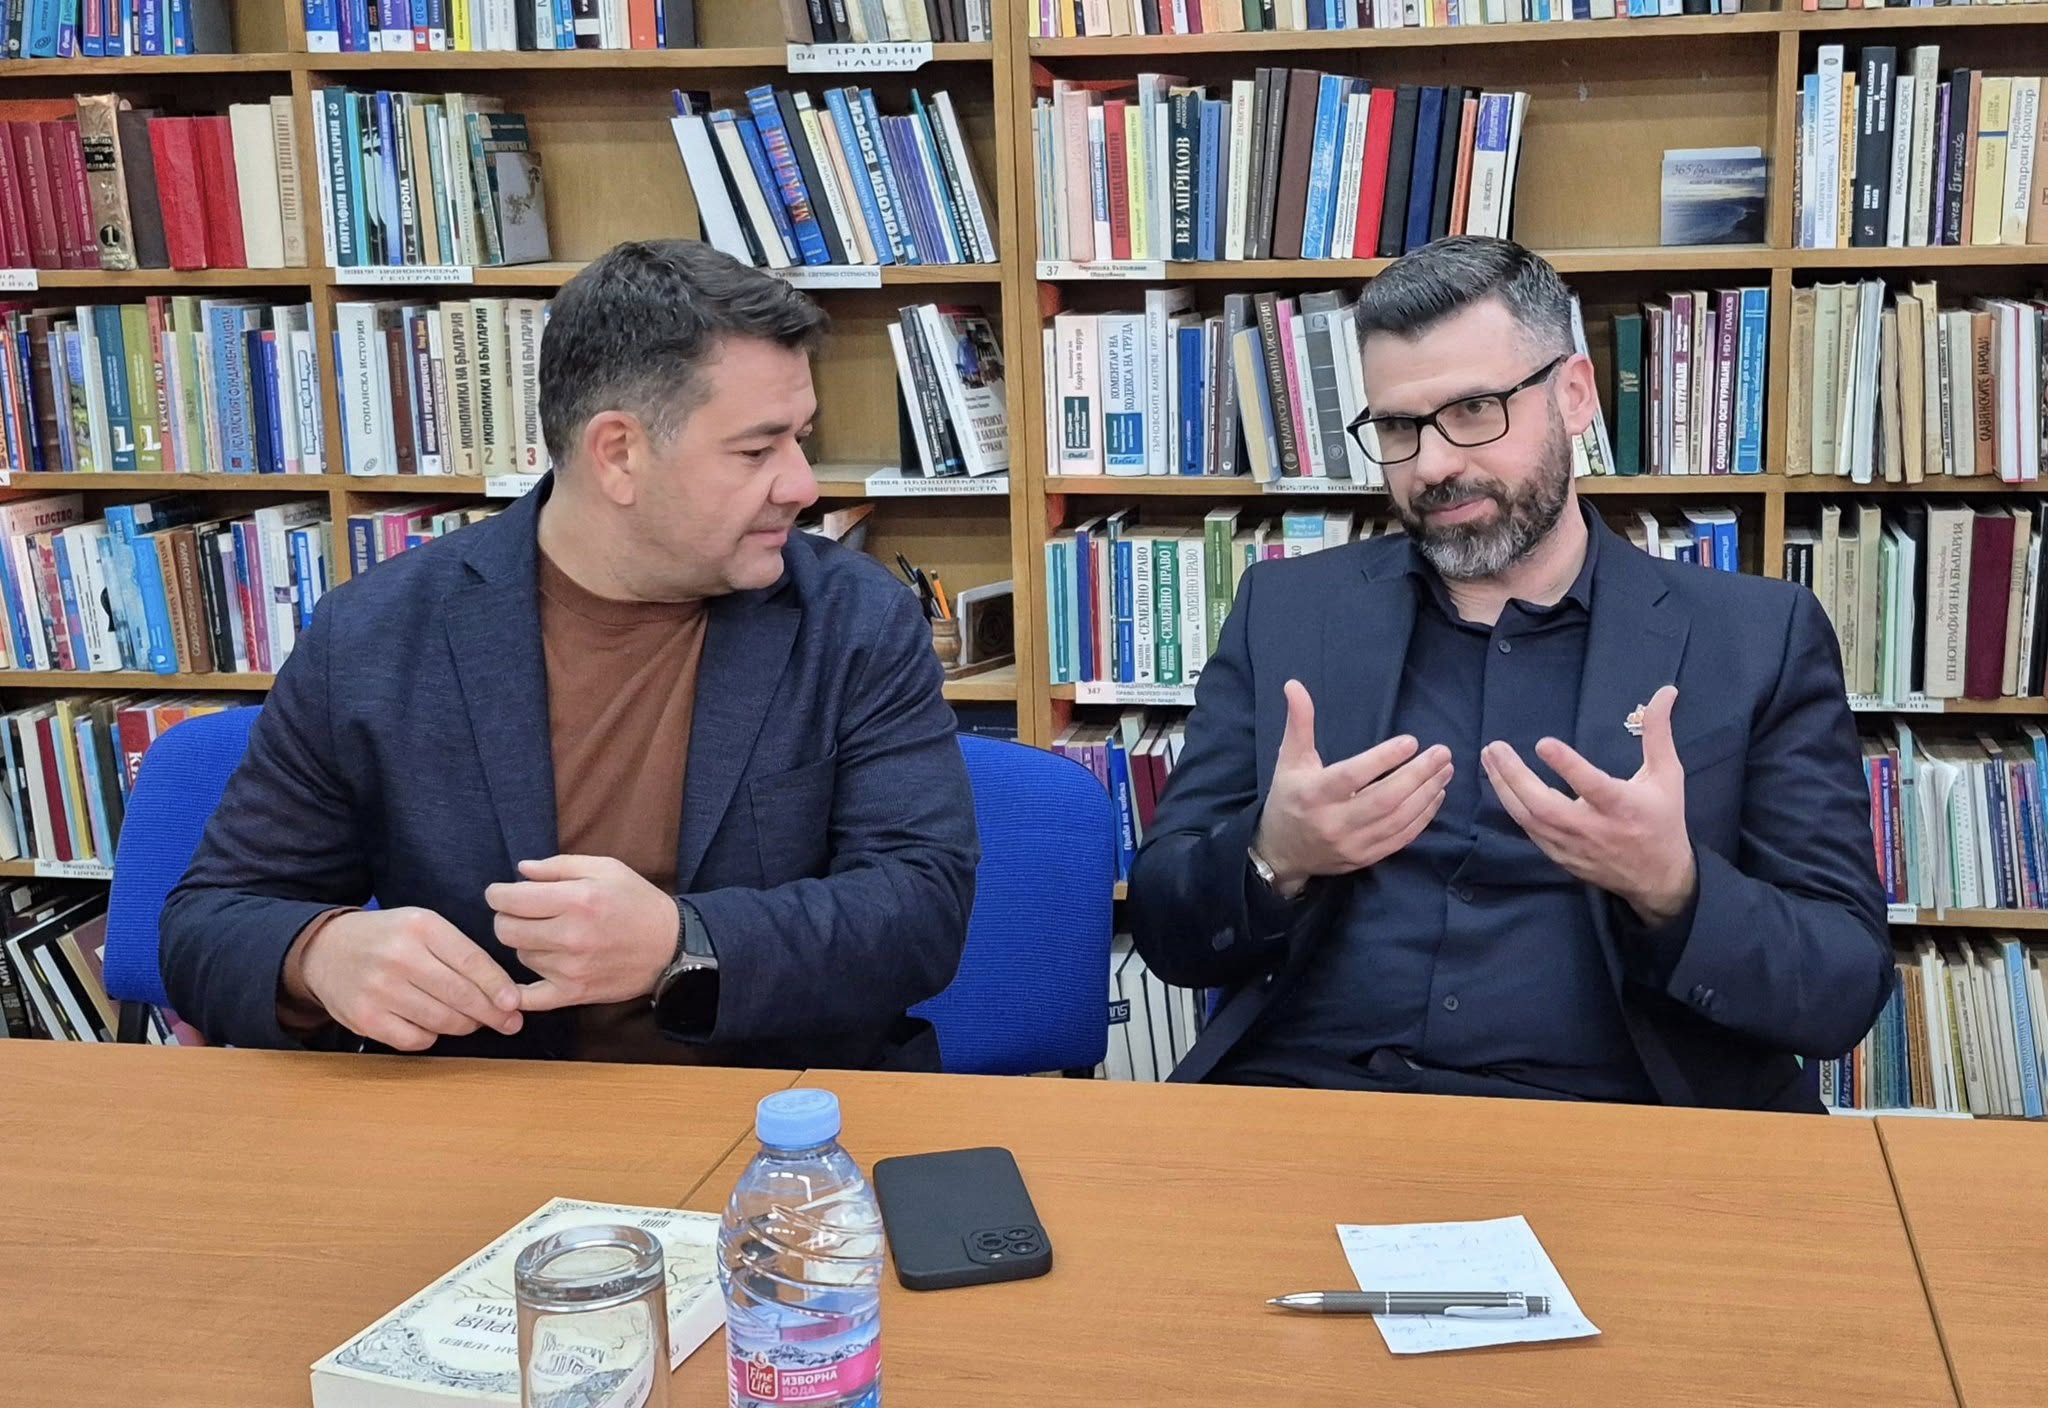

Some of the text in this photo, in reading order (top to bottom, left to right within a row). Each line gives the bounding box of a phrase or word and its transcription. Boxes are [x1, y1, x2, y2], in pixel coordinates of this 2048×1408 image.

[828, 46, 922, 56] ПРАВНИ
[837, 59, 914, 67] НАУКИ
[1822, 72, 1836, 146] АЛМАНАХ
[1897, 128, 1906, 140] НА
[764, 128, 811, 223] МАРКЕТИНГ
[1175, 137, 1191, 215] АПРИЛОВ
[1895, 144, 1906, 195] РАЖДАНЕТО
[2015, 89, 2036, 210] Български фолклор
[334, 177, 345, 191] НА
[401, 178, 413, 225] ЕВРОПА
[849, 101, 904, 256] СТОКОВИ БОРСИ
[336, 194, 351, 254] ГЕОГРАФИЯ
[949, 200, 969, 256] МАРКЕТИНГ
[966, 189, 990, 256] МАРКЕТИНГ
[1046, 266, 1059, 276] 37
[451, 312, 469, 365] БЪЛГАРИЯ
[1260, 301, 1277, 350] ИСТОРИЯ
[1724, 296, 1734, 330] ПАВЛОВ
[357, 320, 373, 435] СТОПАНСКА ИСТОРИЯ
[456, 367, 466, 380] НА
[476, 308, 494, 465] 2 ИКОНОМИКА НА БЪЛГАРИЯ
[520, 309, 537, 465] 3 ИКОНОМИКА НА БЪЛГАРИЯ
[1109, 335, 1120, 399] КОМЕНТАР НА
[1123, 323, 1136, 410] КОДЕКСА НА ТРУДА
[1151, 354, 1159, 391] КМЕТОВЕ
[1719, 360, 1731, 421] ОСИГУРЯВАНЕ
[457, 382, 473, 449] ИКОНОМИКА
[1151, 394, 1160, 452] ТЪРНОВСКИТЕ
[1977, 378, 1992, 441] СЛАВЯНСКИТЕ
[1716, 422, 1728, 469] СОЦИАЛНО
[1186, 549, 1198, 577] ПРАВО
[1136, 546, 1150, 635] СЕМЕЙНО ПРАВО
[1158, 550, 1172, 639] СЕМЕЙНО ПРАВО
[1186, 579, 1200, 622] СЕМЕЙНО
[1946, 522, 1963, 681] ЕТНОГРАФИЯ НА БЪЛГАРИЯ
[1192, 633, 1200, 659] НЕНОВА
[1124, 830, 1134, 850] Права
[750, 1366, 773, 1382] Fine
[750, 1379, 772, 1394] Life
[782, 1370, 838, 1386] ИЗВОРНА
[782, 1386, 816, 1396] ВОДА
